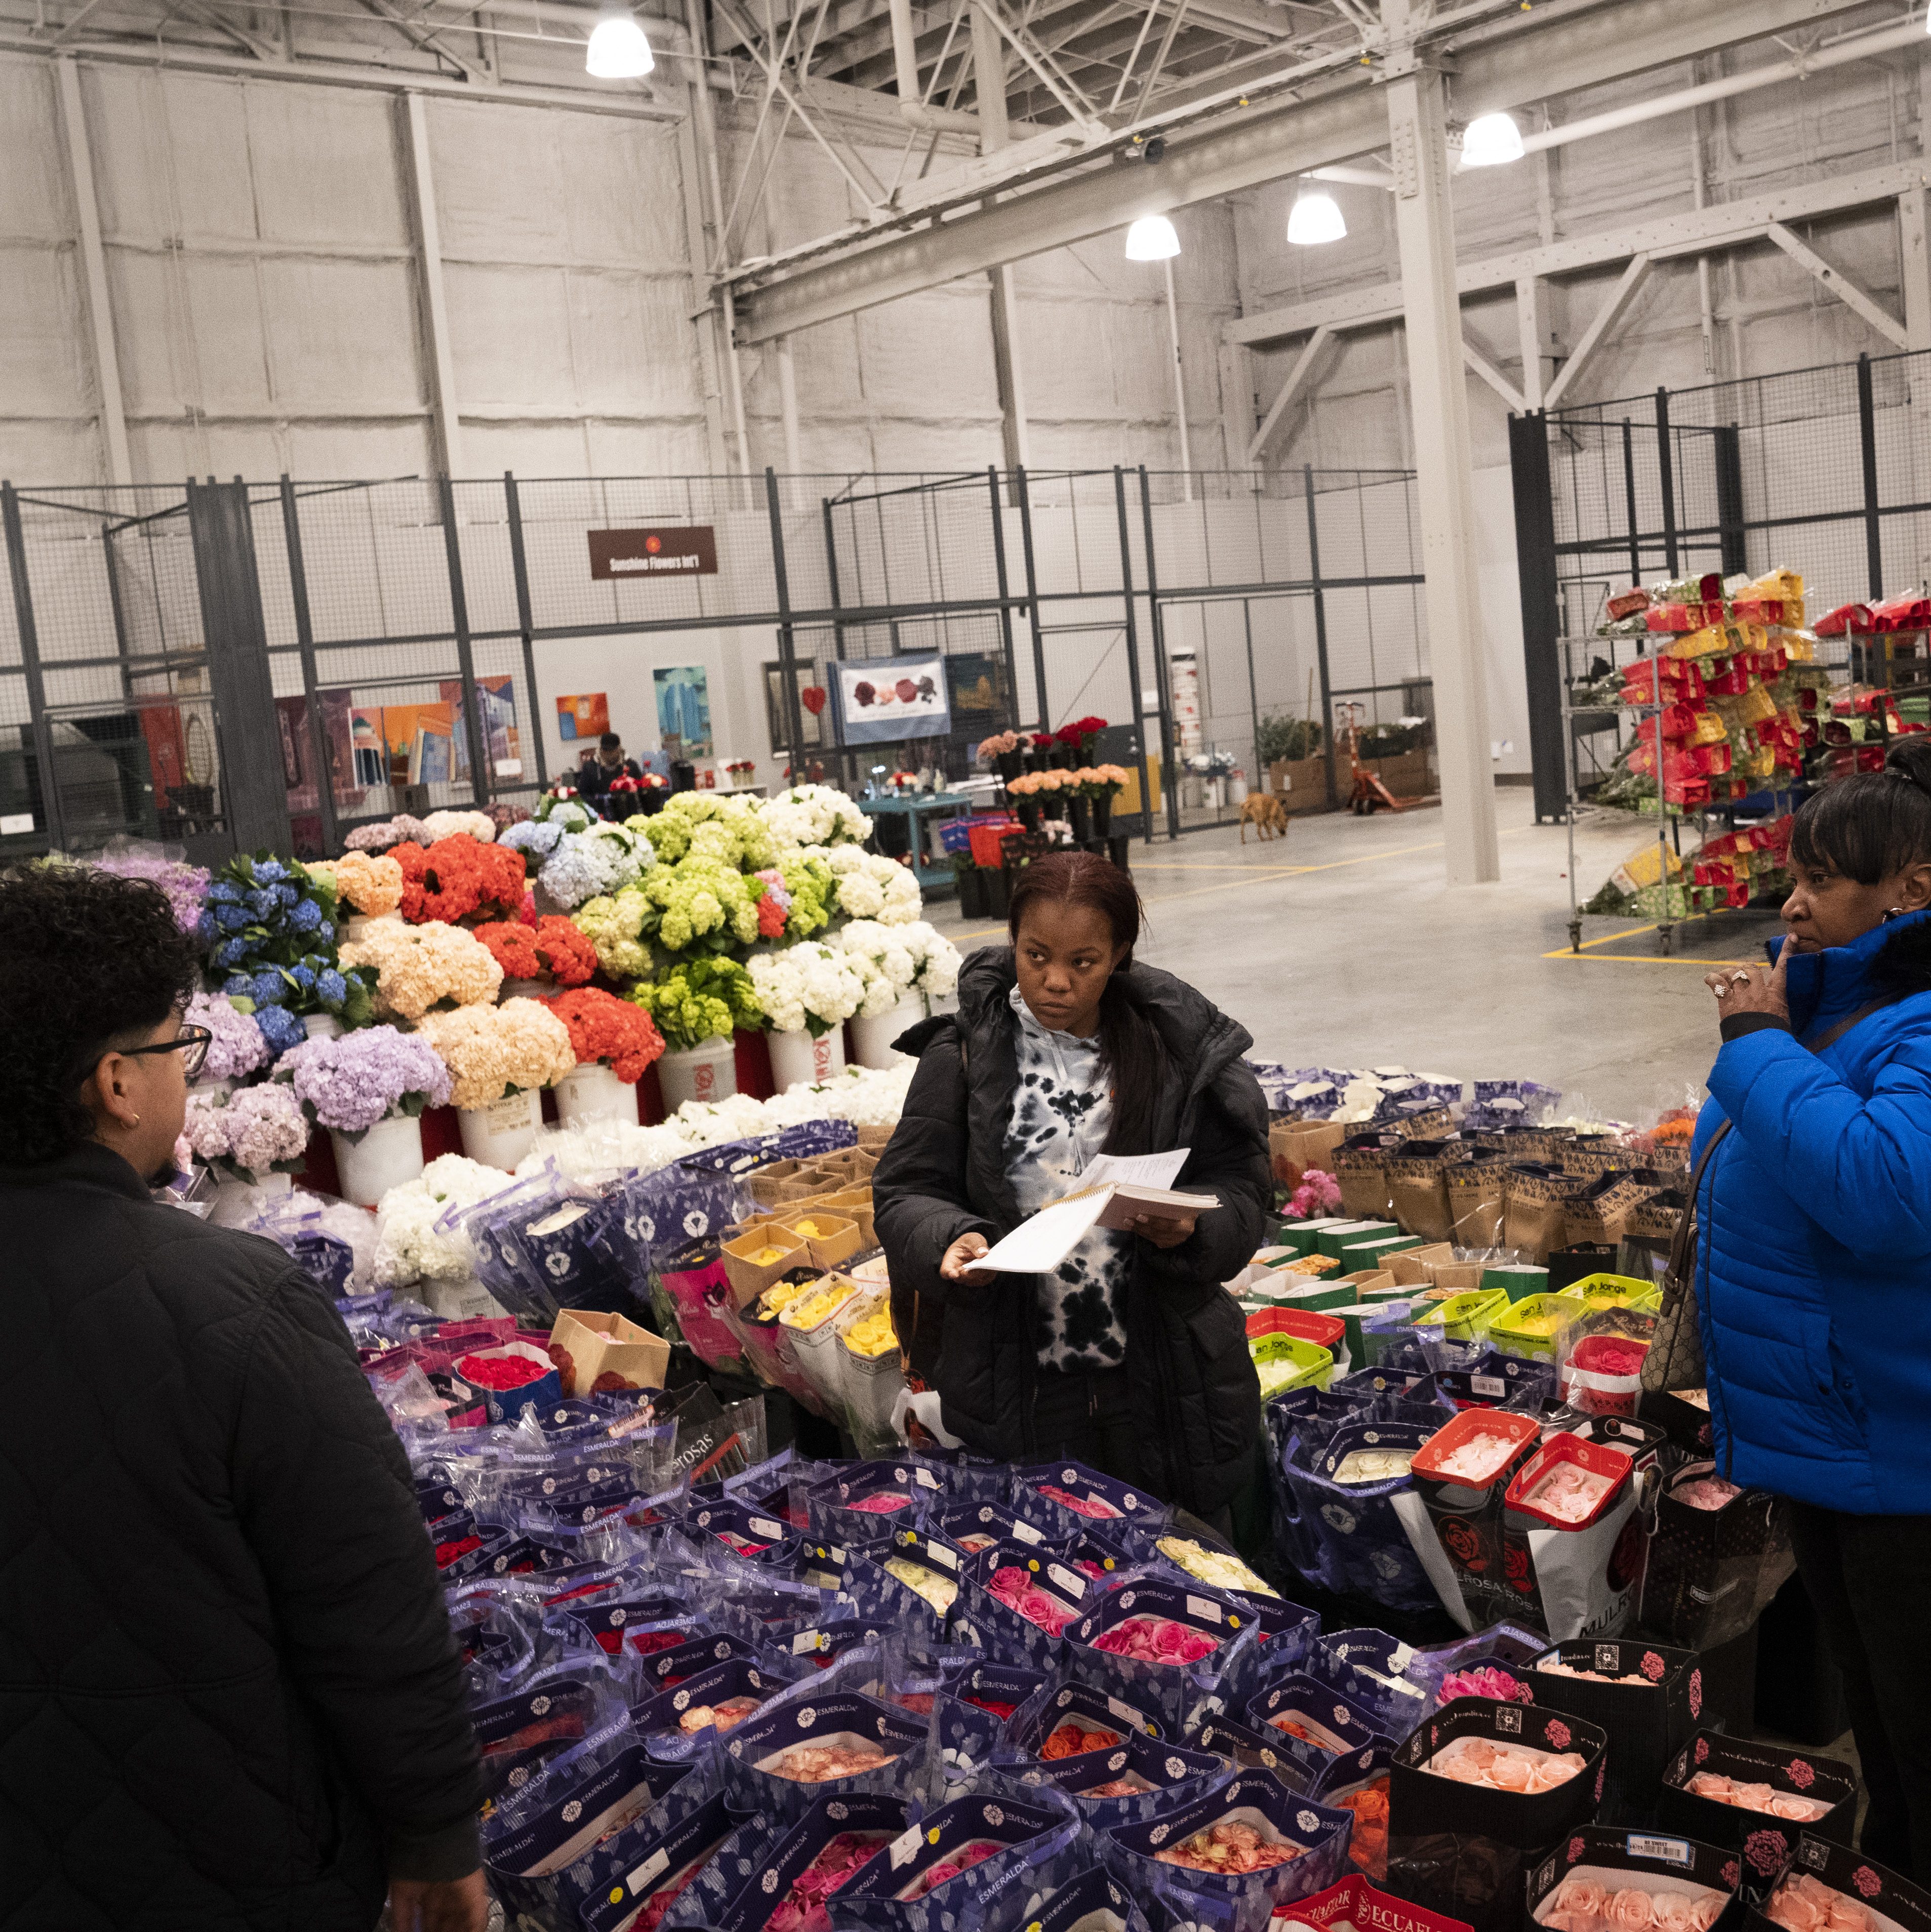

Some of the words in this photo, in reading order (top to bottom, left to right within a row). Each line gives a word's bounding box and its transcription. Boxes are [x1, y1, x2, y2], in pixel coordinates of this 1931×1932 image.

[1599, 1282, 1626, 1294] Jorge
[584, 1439, 619, 1453] ESMERALDA
[513, 1454, 555, 1462] ESMERALDA
[1357, 1480, 1398, 1496] ESMERALDA
[580, 1512, 619, 1534] ESMERALDA
[593, 1559, 629, 1580] ESMERALDA
[525, 1583, 561, 1593] ESMERALDA
[1136, 1590, 1175, 1601] ESMERALDA
[1252, 1603, 1284, 1616] ESMERALDA
[963, 1609, 996, 1634] ESMERALDA
[982, 1680, 1020, 1692] ESMERALDA
[476, 1710, 515, 1728] ESMERALDA
[817, 1705, 858, 1716] ESMERALDA
[586, 1711, 631, 1749] ESMERALDA
[502, 1770, 551, 1812] ESMERALDA
[581, 1768, 619, 1803] ESMERALDA
[490, 1834, 535, 1862] ESMERALDA
[776, 1831, 808, 1871] ESMERALDA
[980, 1856, 1029, 1904] ESMERALDA
[1372, 1907, 1441, 1932] ECUAFL
